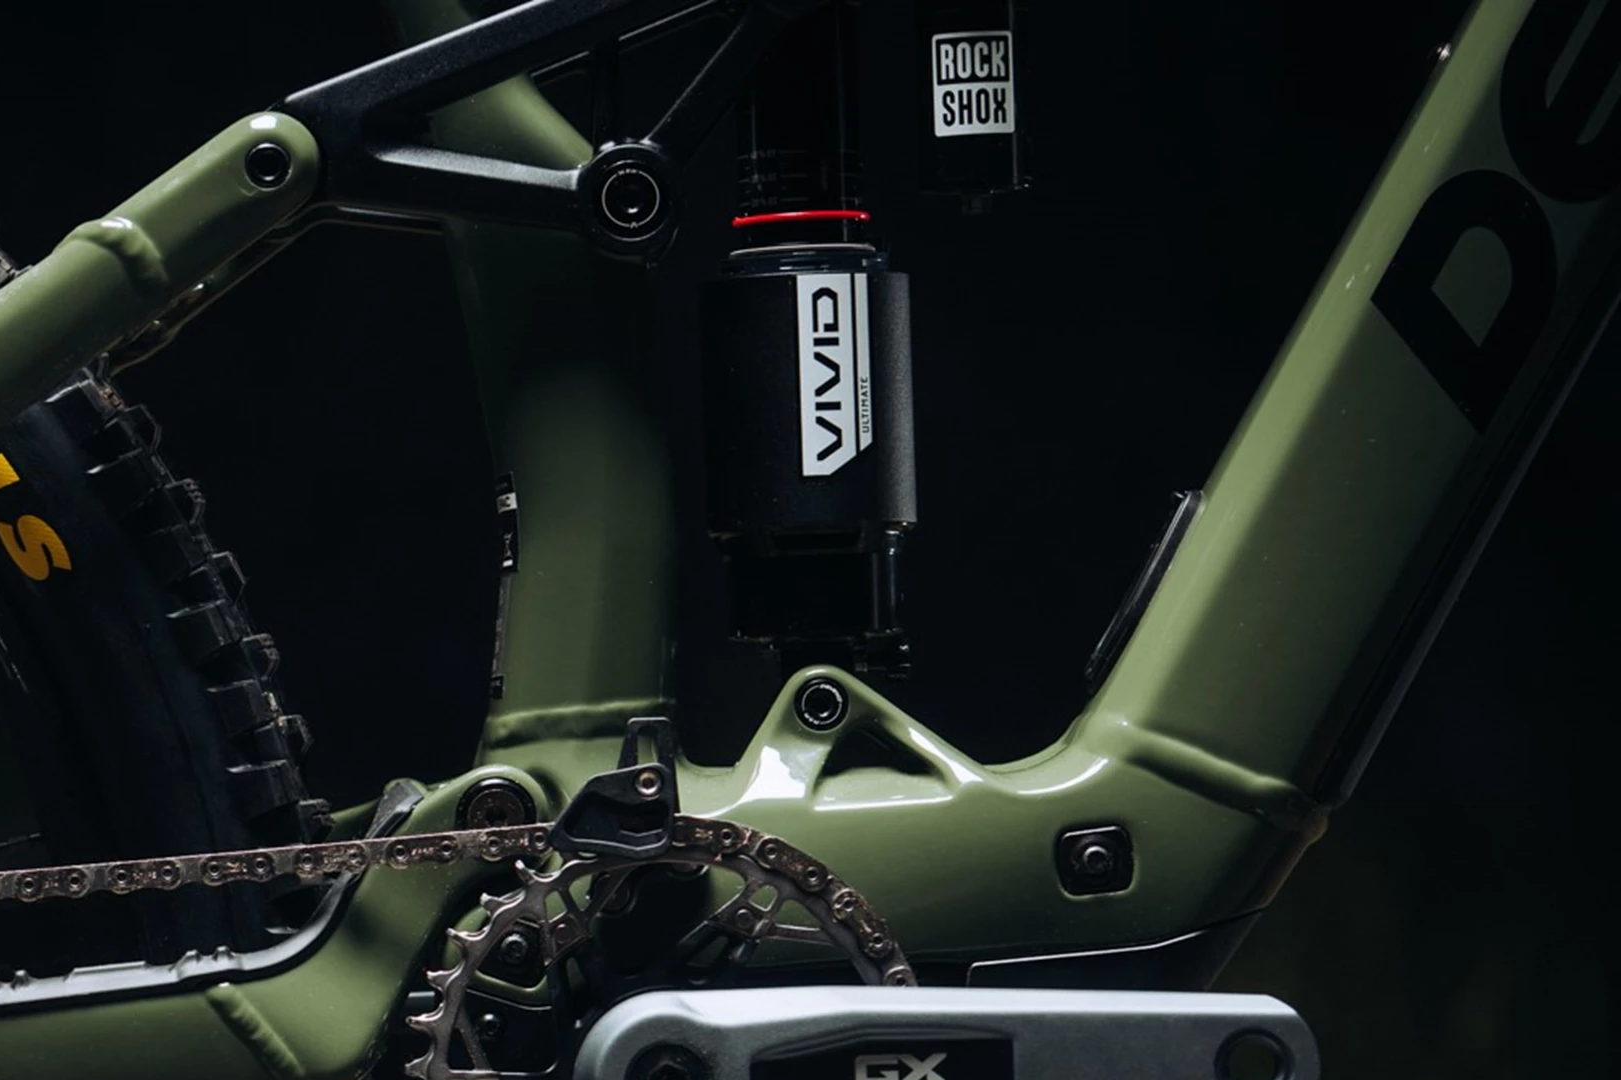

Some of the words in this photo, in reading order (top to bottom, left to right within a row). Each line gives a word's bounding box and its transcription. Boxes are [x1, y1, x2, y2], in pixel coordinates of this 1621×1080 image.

[939, 40, 1007, 81] ROCK
[942, 88, 1007, 126] SHOX
[812, 287, 843, 461] VIVID
[860, 376, 871, 434] ULTIMATE
